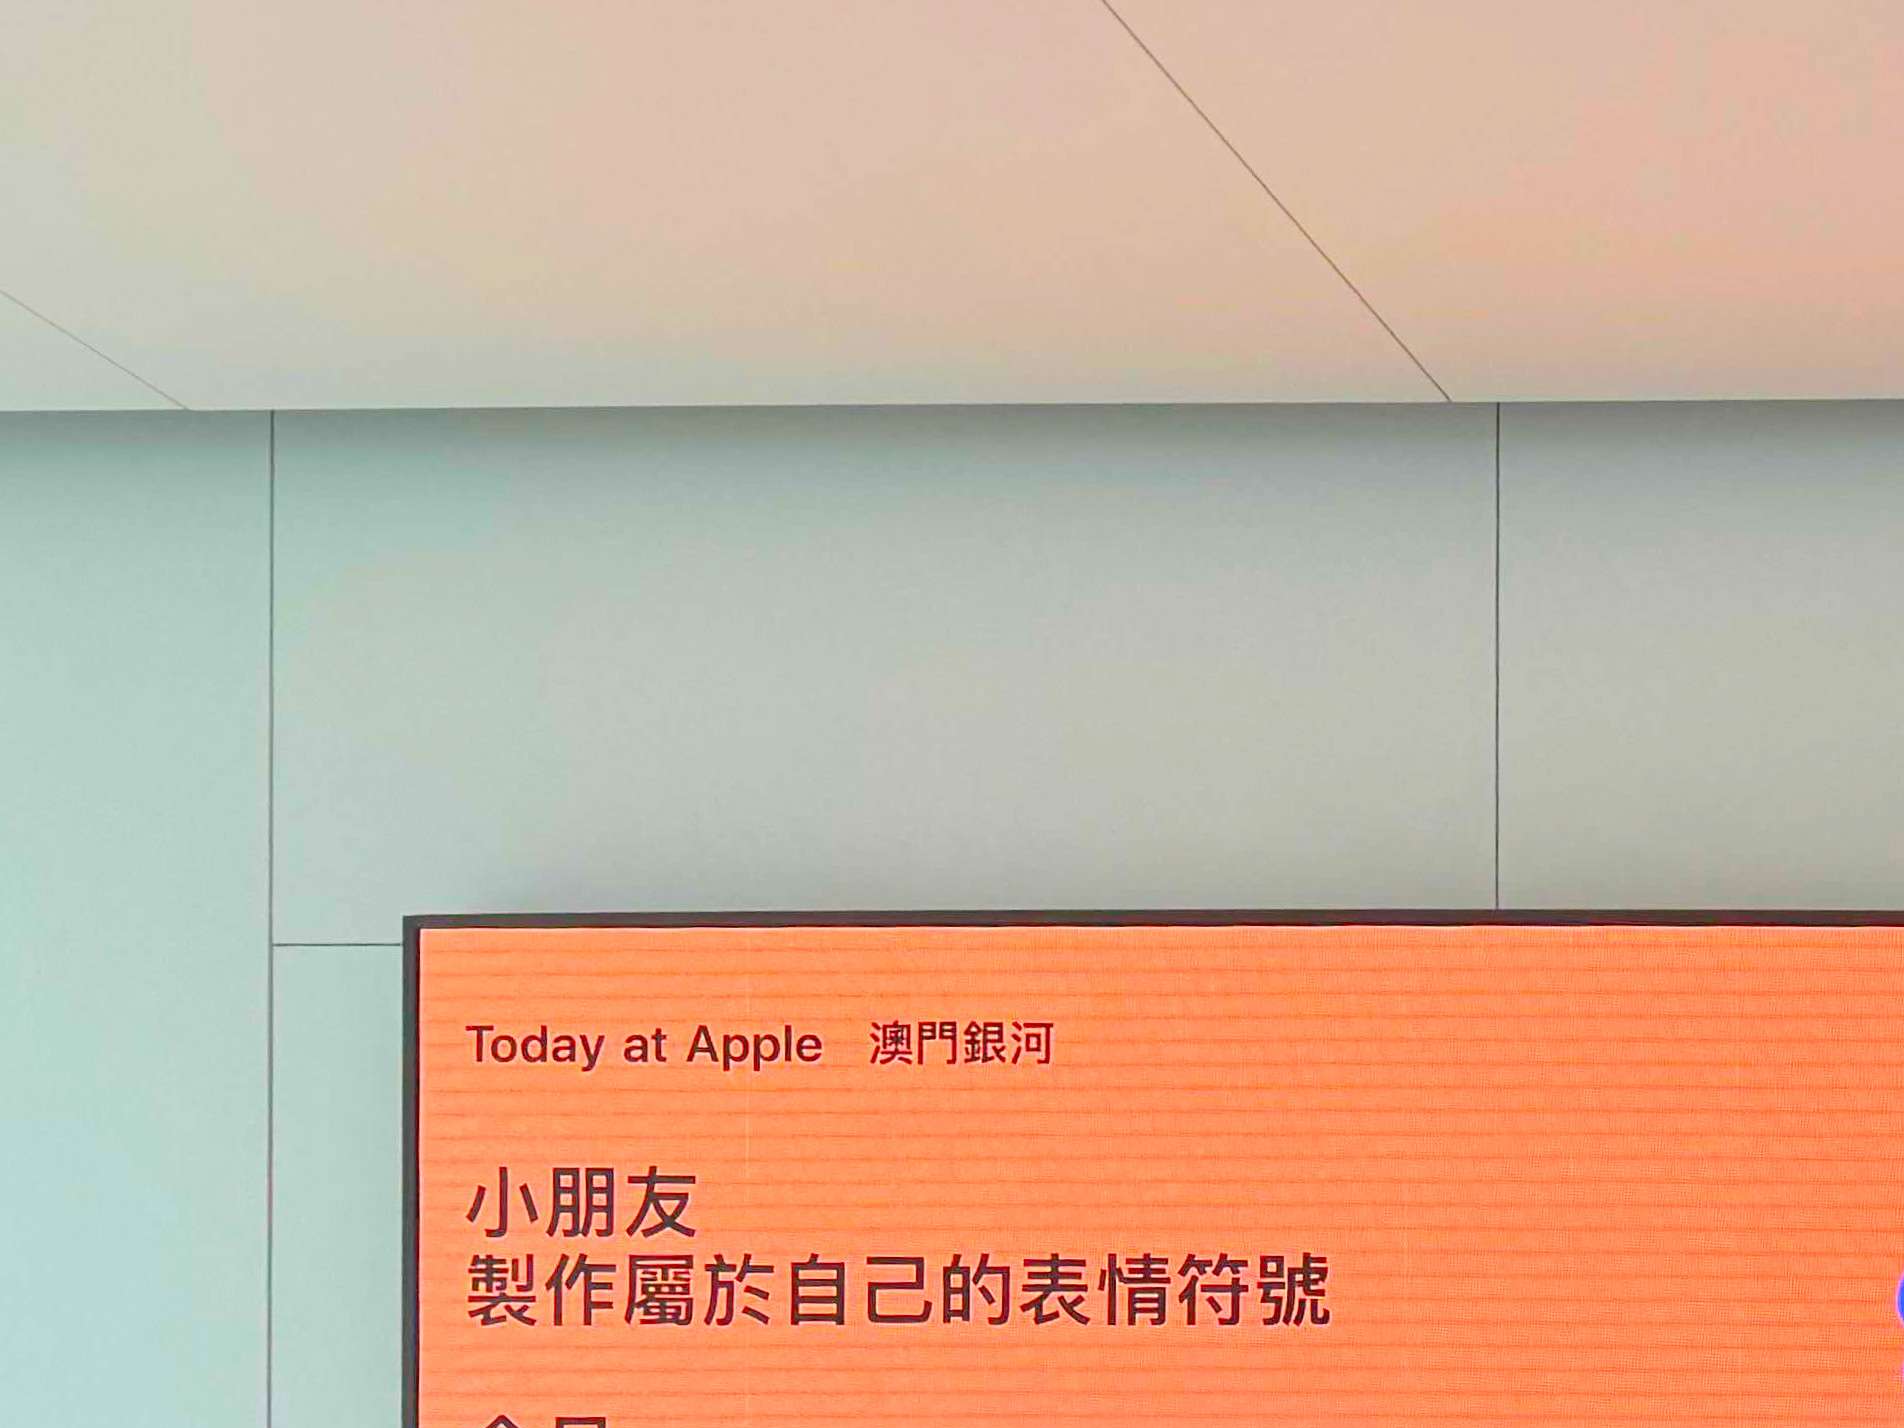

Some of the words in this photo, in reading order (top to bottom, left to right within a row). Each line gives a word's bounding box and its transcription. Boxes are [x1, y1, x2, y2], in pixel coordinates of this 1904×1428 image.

[466, 1025, 605, 1072] Today
[623, 1028, 667, 1063] at
[686, 1025, 822, 1072] Apple
[870, 1020, 1054, 1065] 澳門銀河
[466, 1165, 696, 1238] 小朋友
[467, 1252, 1331, 1327] 製作屬於自己的表情符號
